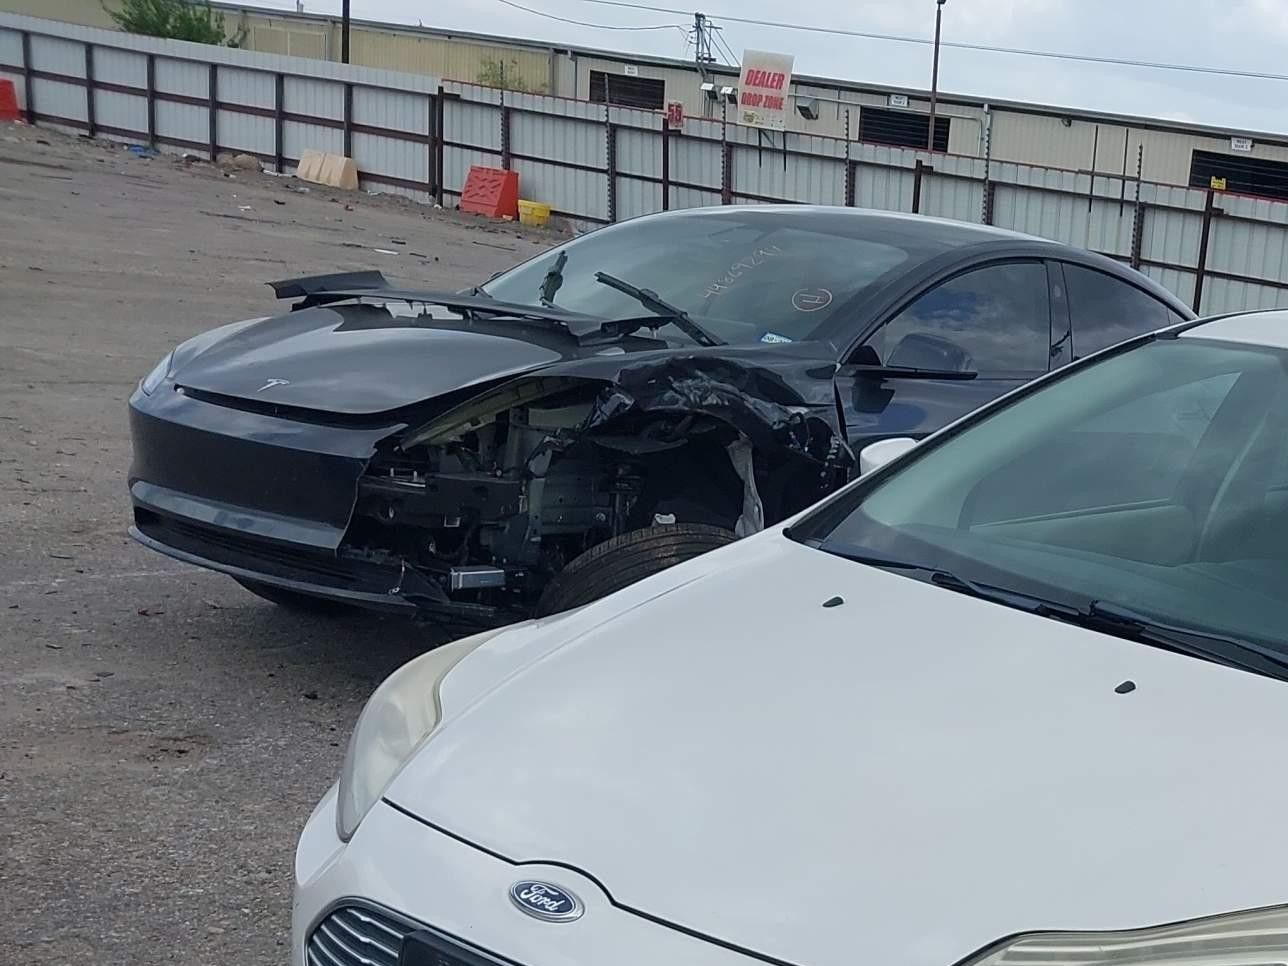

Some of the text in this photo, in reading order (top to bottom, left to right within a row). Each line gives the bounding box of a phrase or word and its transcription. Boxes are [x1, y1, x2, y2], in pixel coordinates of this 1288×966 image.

[745, 69, 785, 90] DEALER
[741, 92, 784, 110] DROP ZONE
[520, 884, 566, 911] Ford
